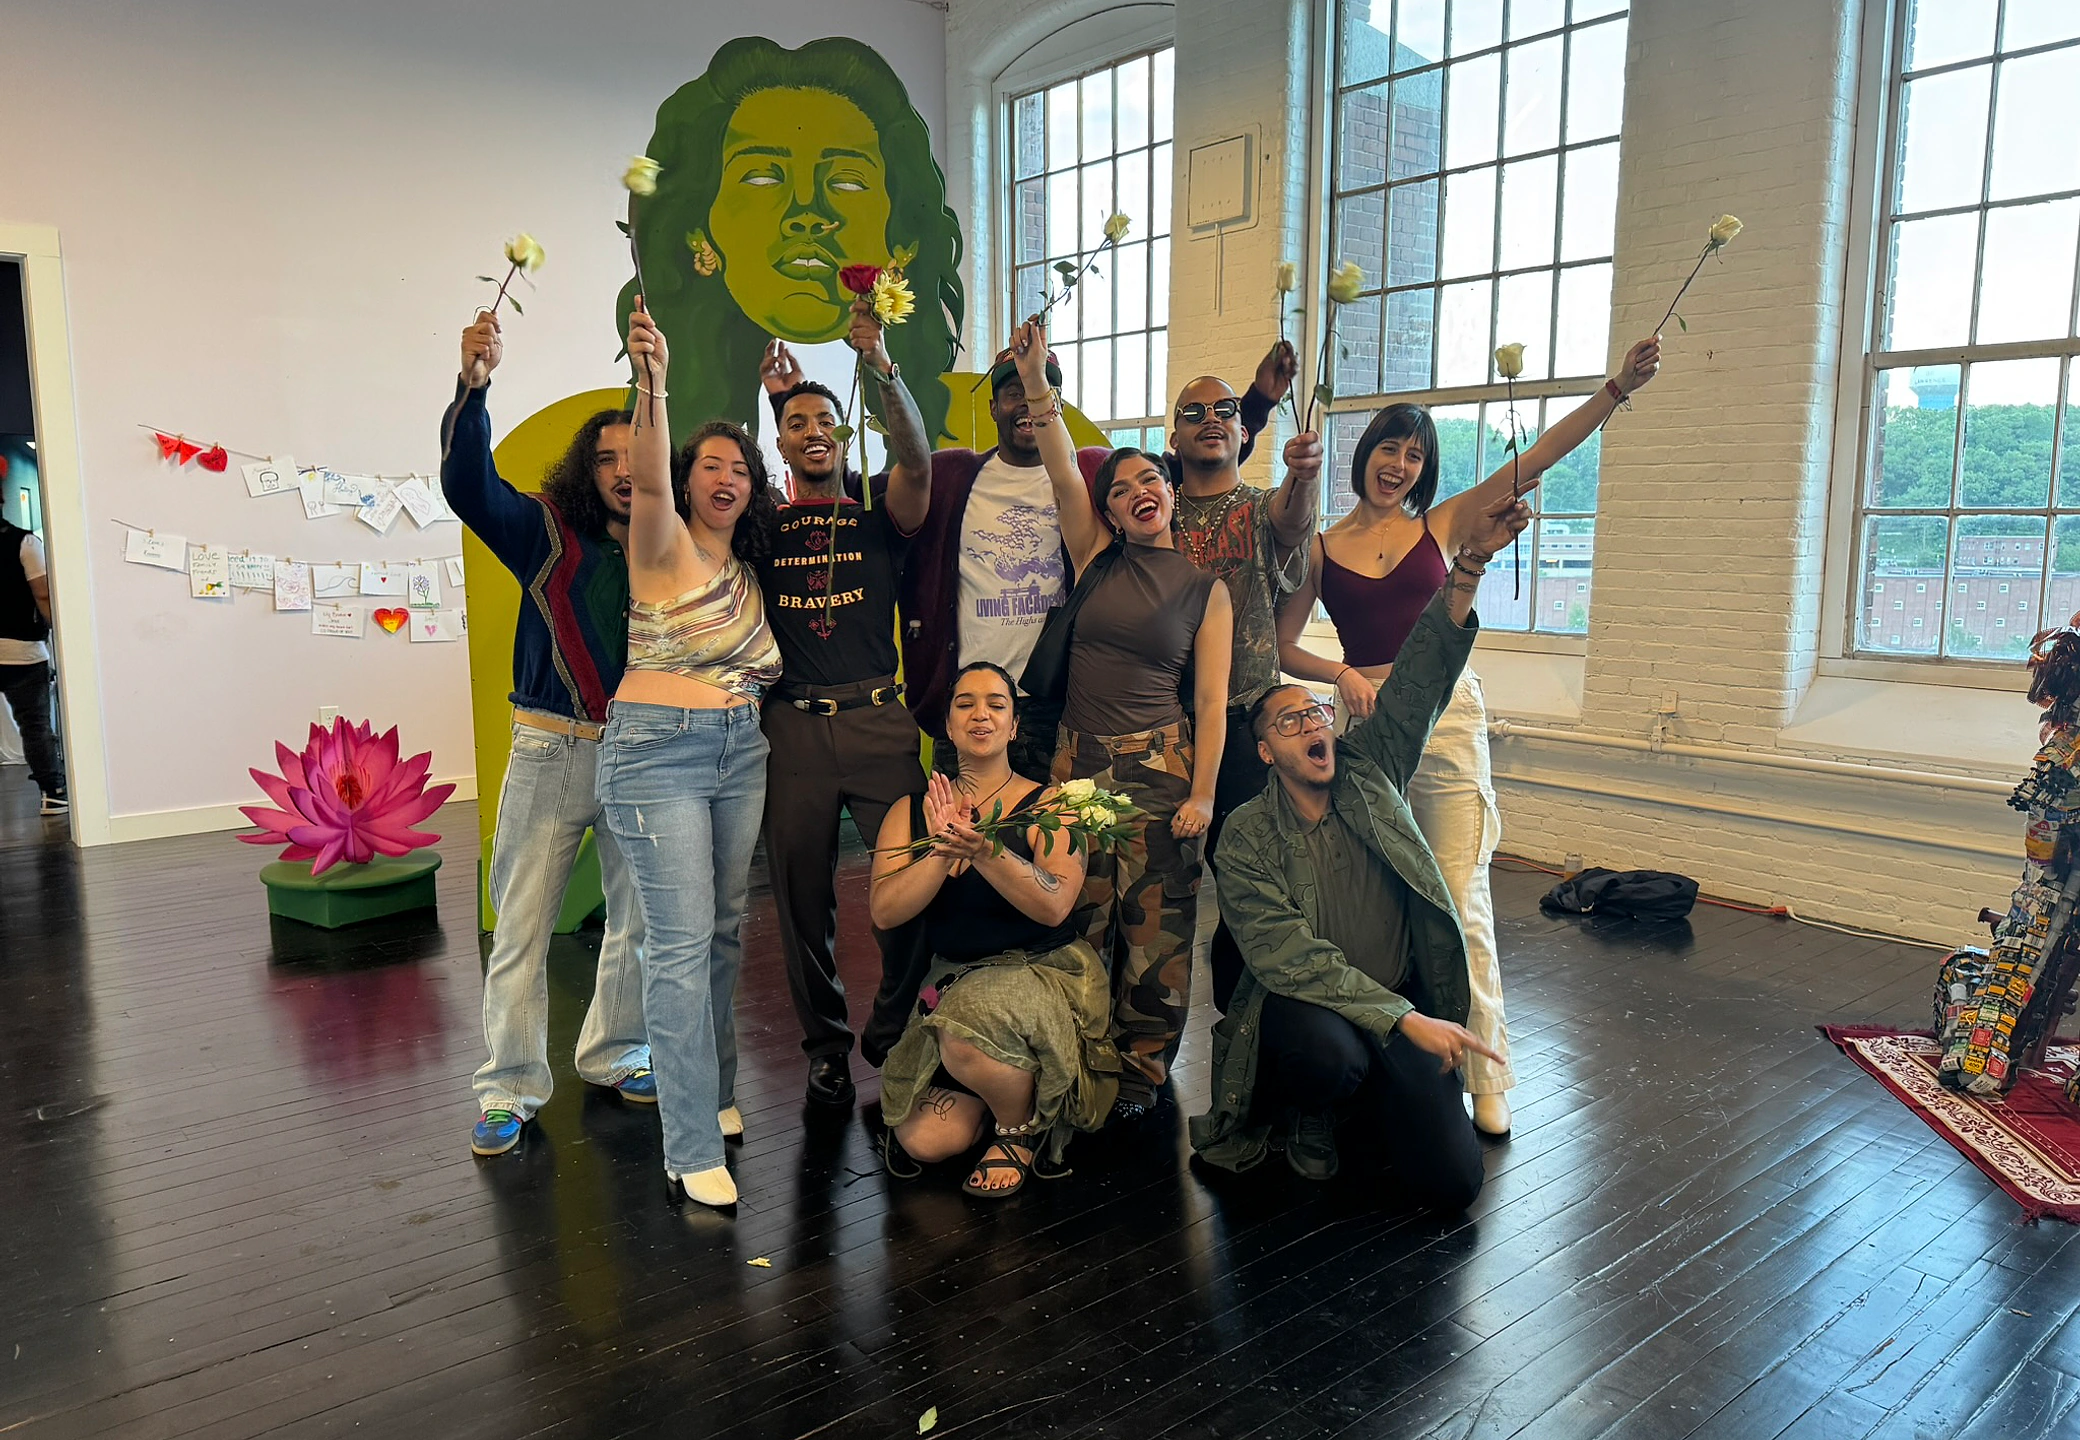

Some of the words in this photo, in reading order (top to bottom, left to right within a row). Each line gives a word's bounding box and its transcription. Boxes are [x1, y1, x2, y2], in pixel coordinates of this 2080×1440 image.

[780, 515, 858, 532] COURAGE
[773, 551, 863, 568] DETERMINTION
[778, 587, 864, 609] BRAVERY
[976, 597, 1010, 618] LIVING
[1001, 617, 1014, 626] The
[1015, 616, 1037, 627] Highs
